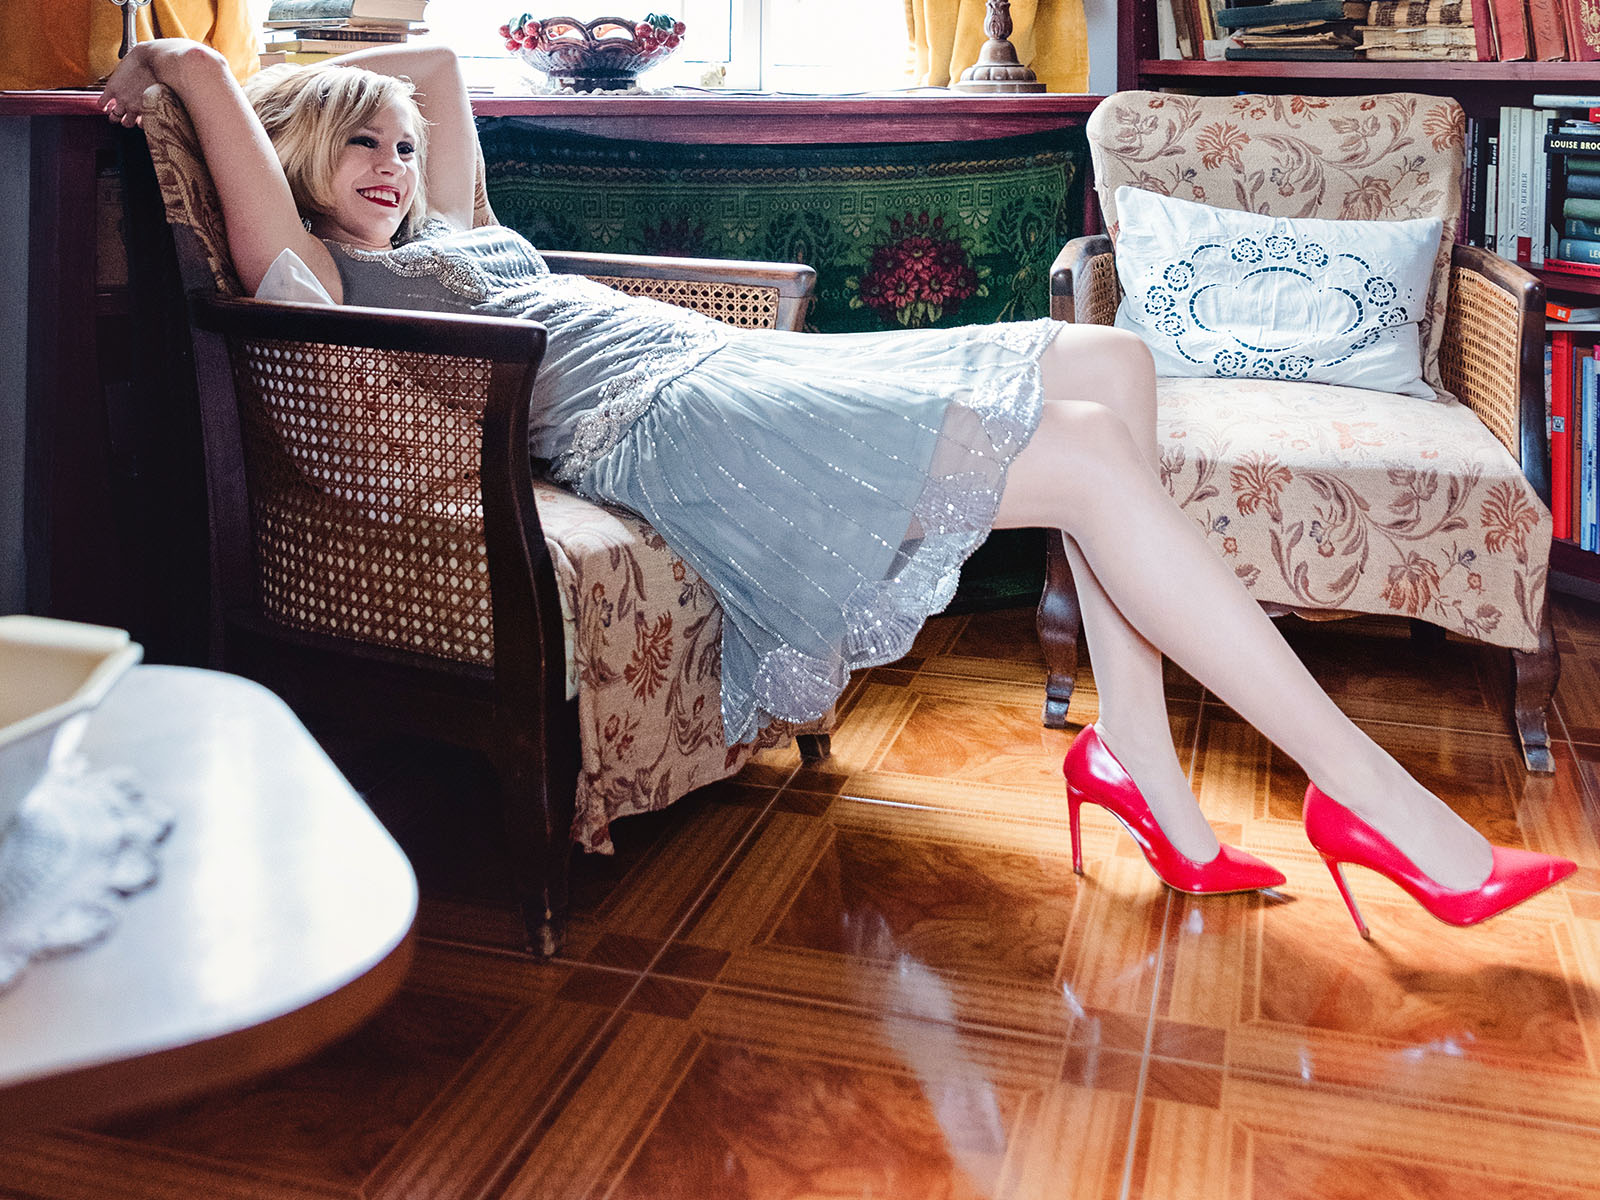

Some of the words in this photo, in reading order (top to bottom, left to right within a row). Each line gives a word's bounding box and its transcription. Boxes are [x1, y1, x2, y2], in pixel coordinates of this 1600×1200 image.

[1550, 140, 1578, 149] LOUISE
[1520, 172, 1528, 204] BERBER
[1519, 206, 1527, 233] ANITA
